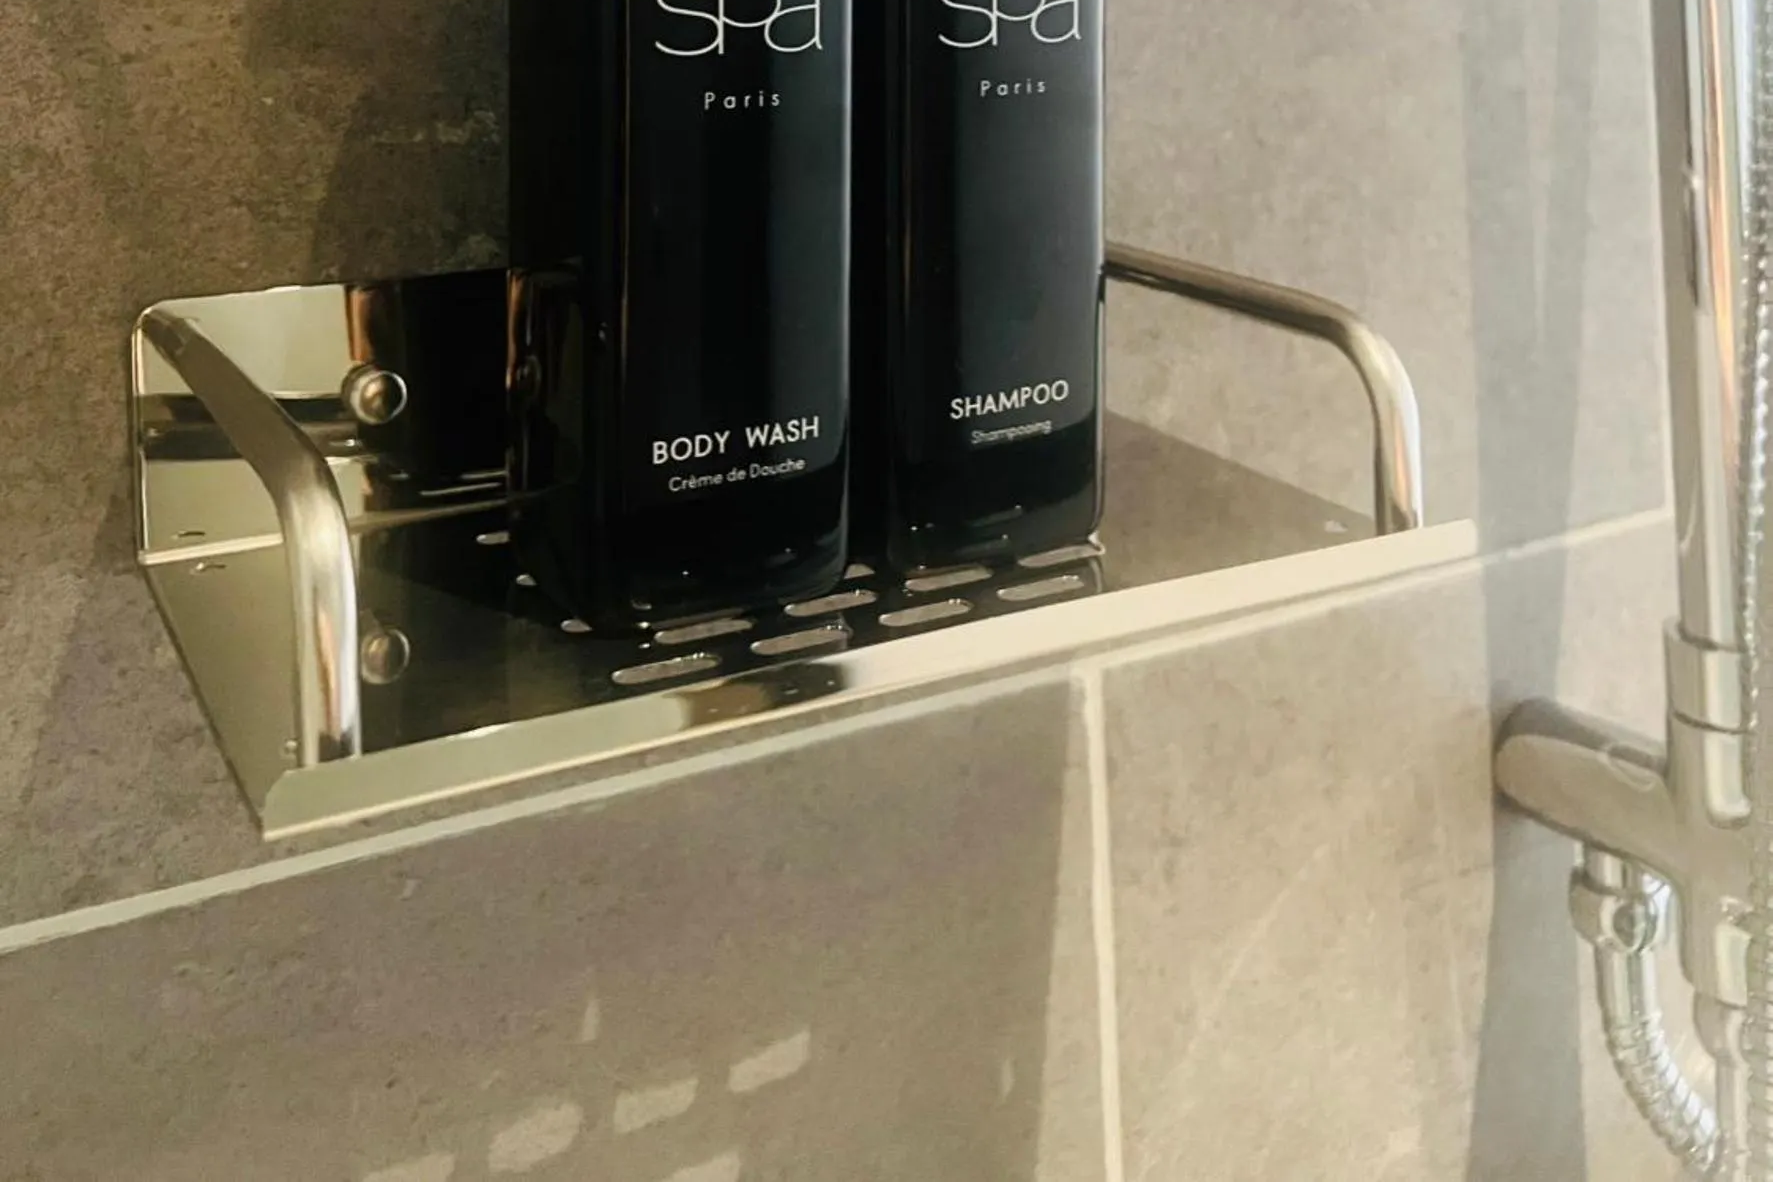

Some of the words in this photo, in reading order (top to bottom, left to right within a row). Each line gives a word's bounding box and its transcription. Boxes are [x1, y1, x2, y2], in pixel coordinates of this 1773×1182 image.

[704, 90, 782, 111] Paris
[980, 77, 1046, 97] Paris
[950, 379, 1070, 420] SHAMPOO
[652, 429, 731, 465] BODY
[745, 416, 820, 450] WASH
[668, 471, 723, 493] Crème
[726, 466, 747, 483] de
[749, 457, 806, 479] Douche
